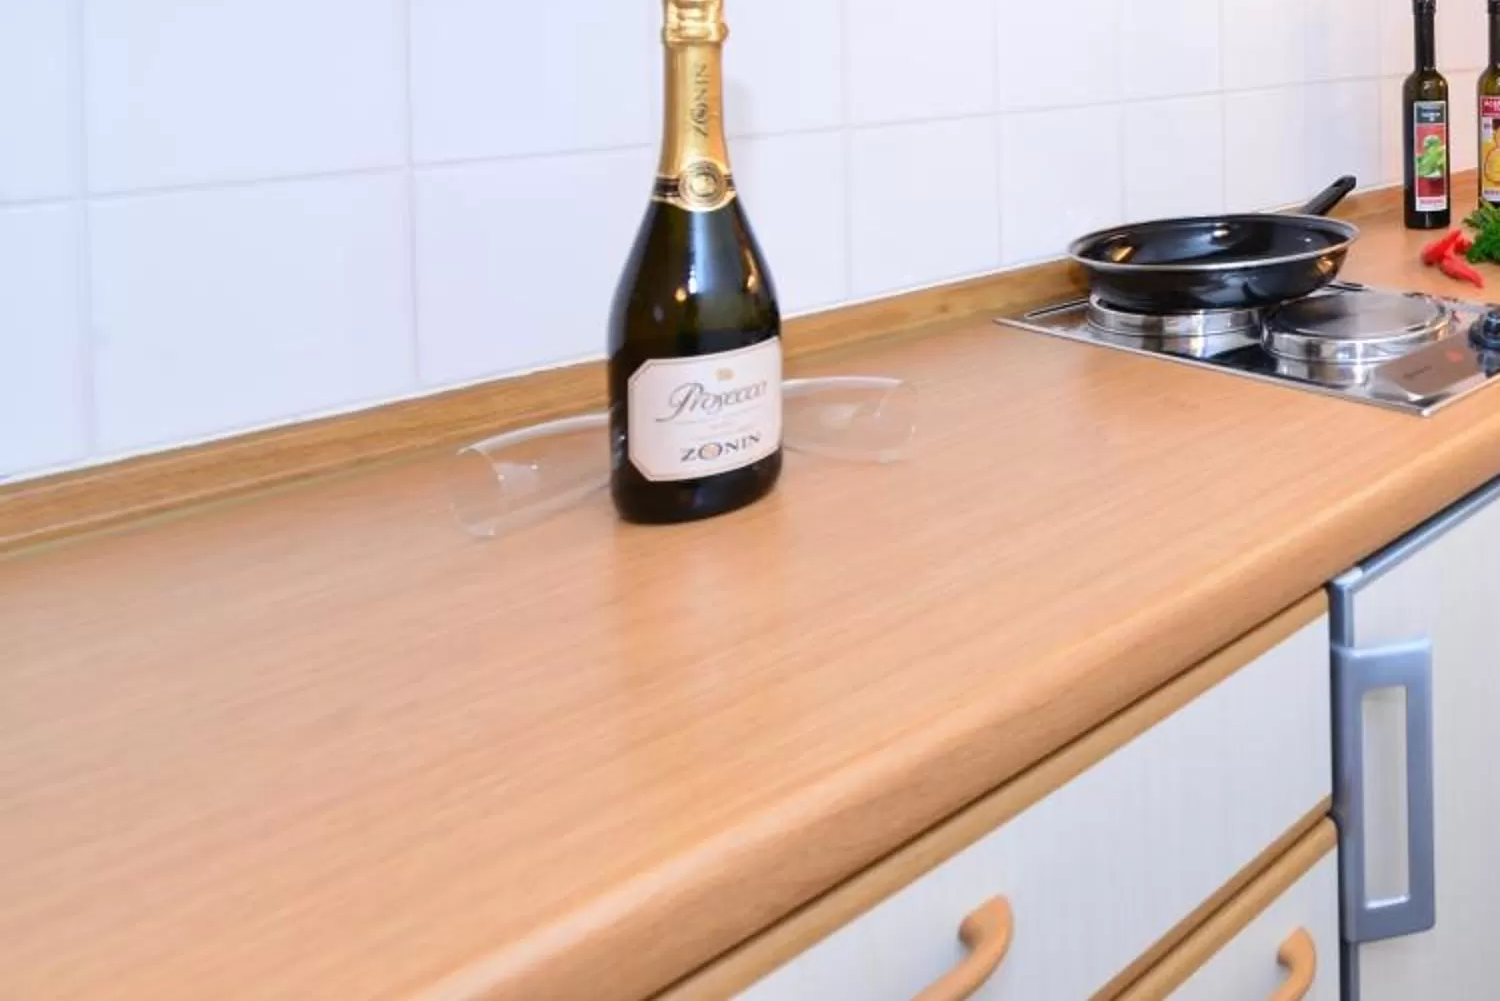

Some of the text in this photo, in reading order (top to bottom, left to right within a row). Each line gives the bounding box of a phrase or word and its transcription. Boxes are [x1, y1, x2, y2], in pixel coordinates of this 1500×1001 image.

[691, 63, 710, 138] ZONIN
[655, 381, 768, 423] Prosecco
[680, 430, 761, 463] ZONIN
